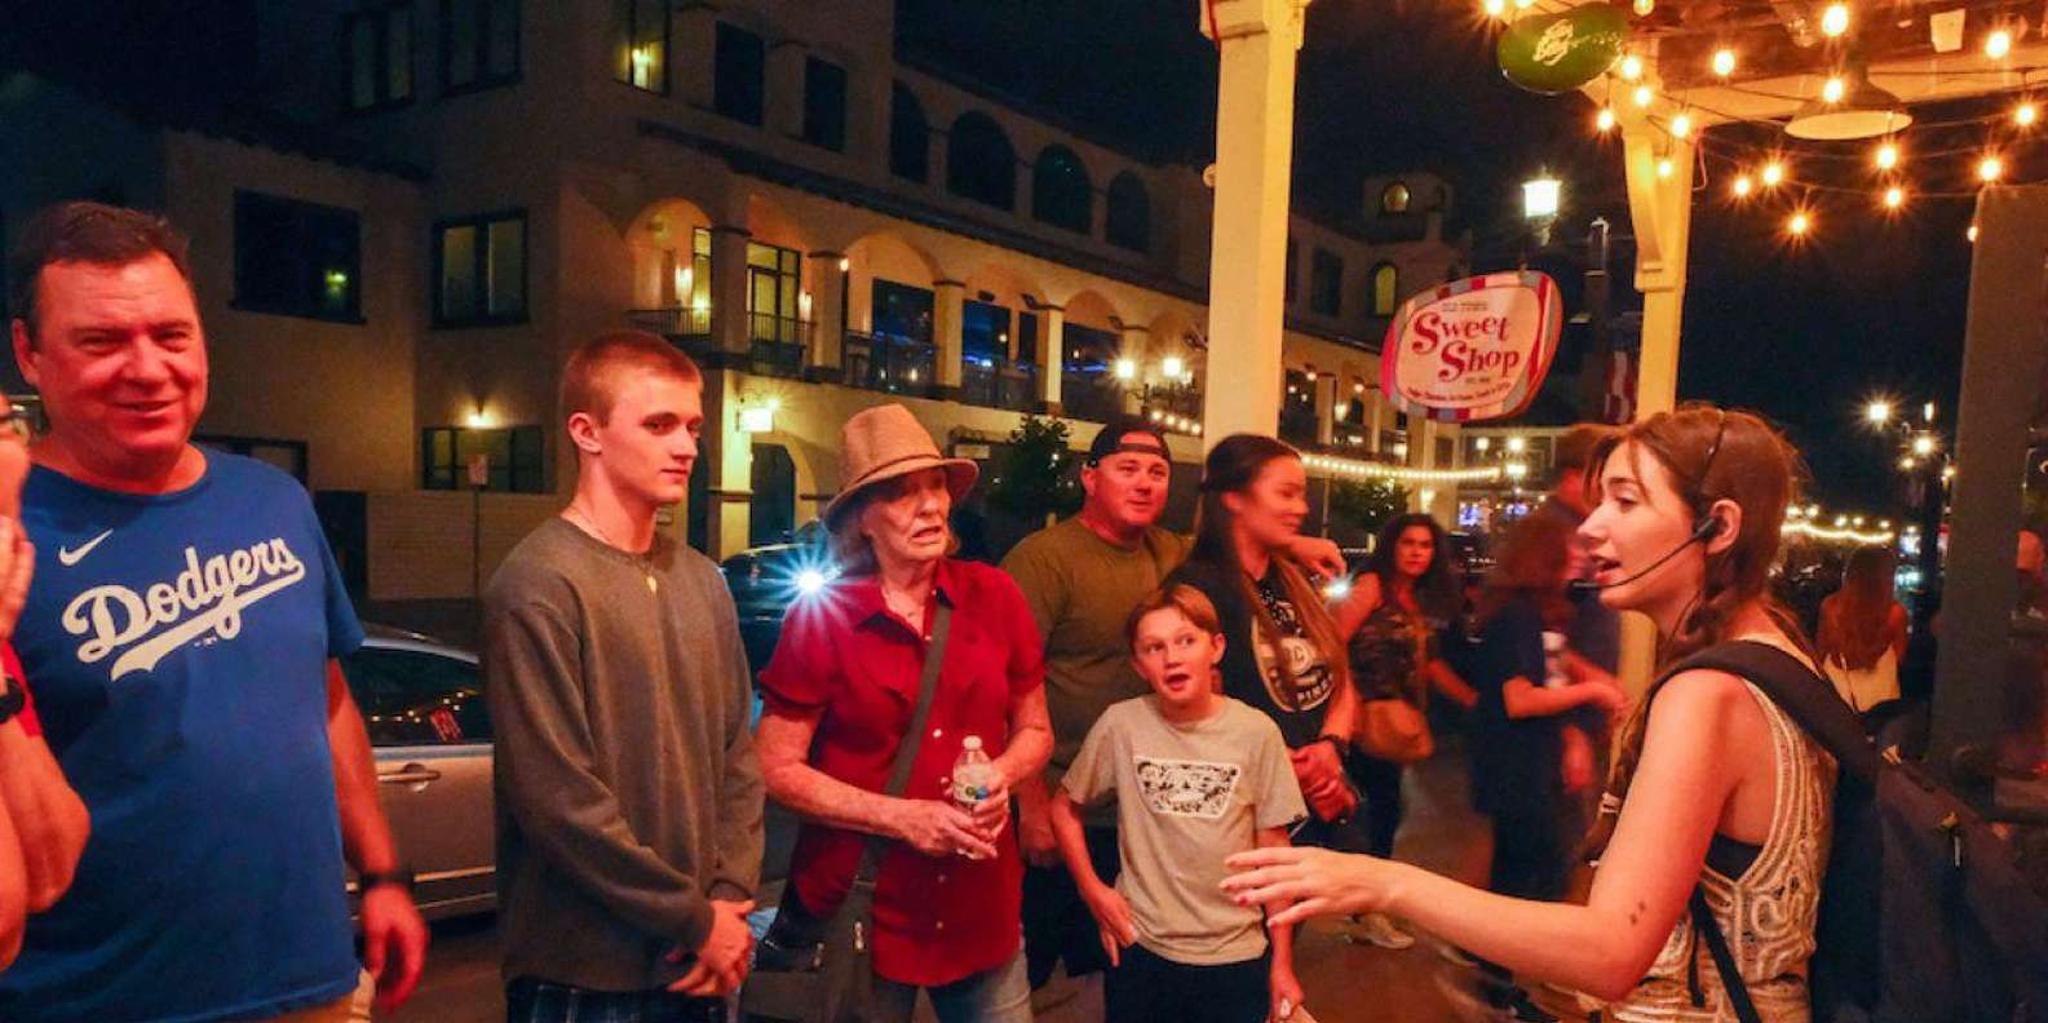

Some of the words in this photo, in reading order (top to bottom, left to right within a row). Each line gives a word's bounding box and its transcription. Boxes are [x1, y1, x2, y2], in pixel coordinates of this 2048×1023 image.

[1412, 311, 1509, 355] Sweet
[1438, 340, 1520, 383] Shop
[61, 537, 305, 664] Dodgers
